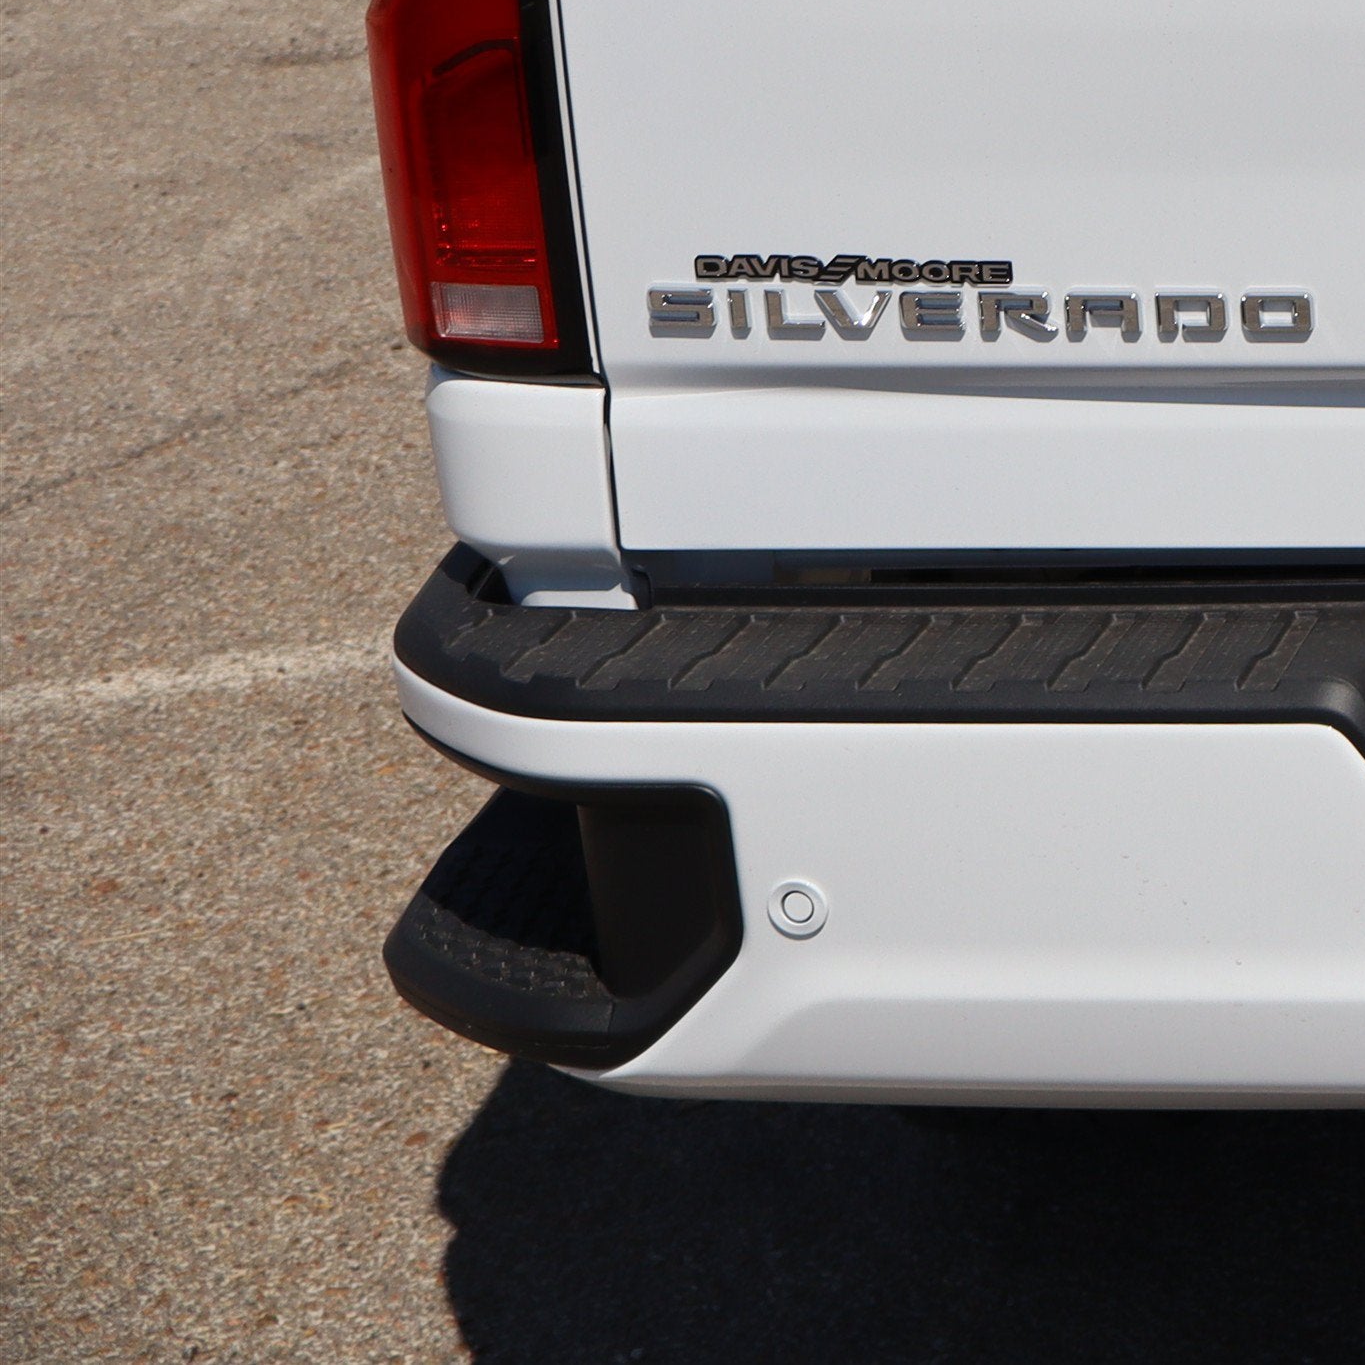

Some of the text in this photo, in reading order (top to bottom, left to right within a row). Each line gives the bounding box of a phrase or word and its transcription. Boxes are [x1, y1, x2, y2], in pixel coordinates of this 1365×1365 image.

[696, 256, 1011, 283] DAVIS MOORE
[648, 286, 1313, 339] SILVERADO
